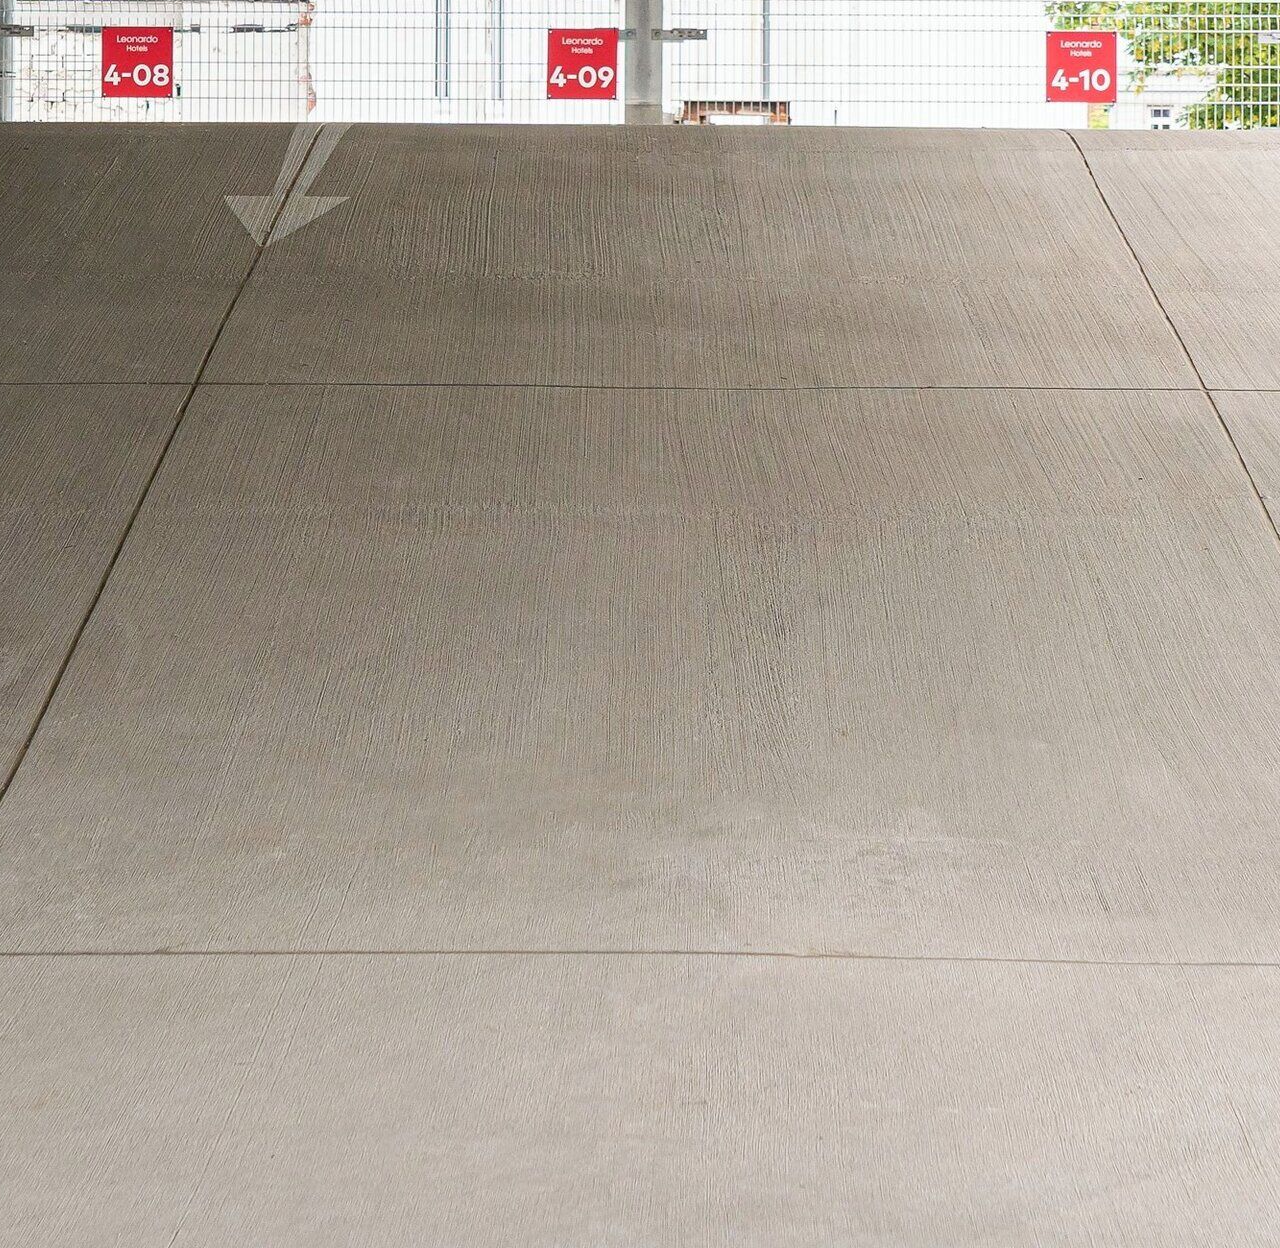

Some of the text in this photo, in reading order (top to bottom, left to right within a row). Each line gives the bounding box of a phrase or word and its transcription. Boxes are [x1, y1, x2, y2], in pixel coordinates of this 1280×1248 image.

[116, 35, 159, 44] Leonardo
[561, 37, 604, 46] Leonardo
[126, 44, 148, 52] Hotels
[1060, 40, 1103, 49] Leonardo
[104, 64, 170, 87] 4-08
[549, 65, 615, 88] 4-09
[1051, 68, 1111, 92] 4-10
